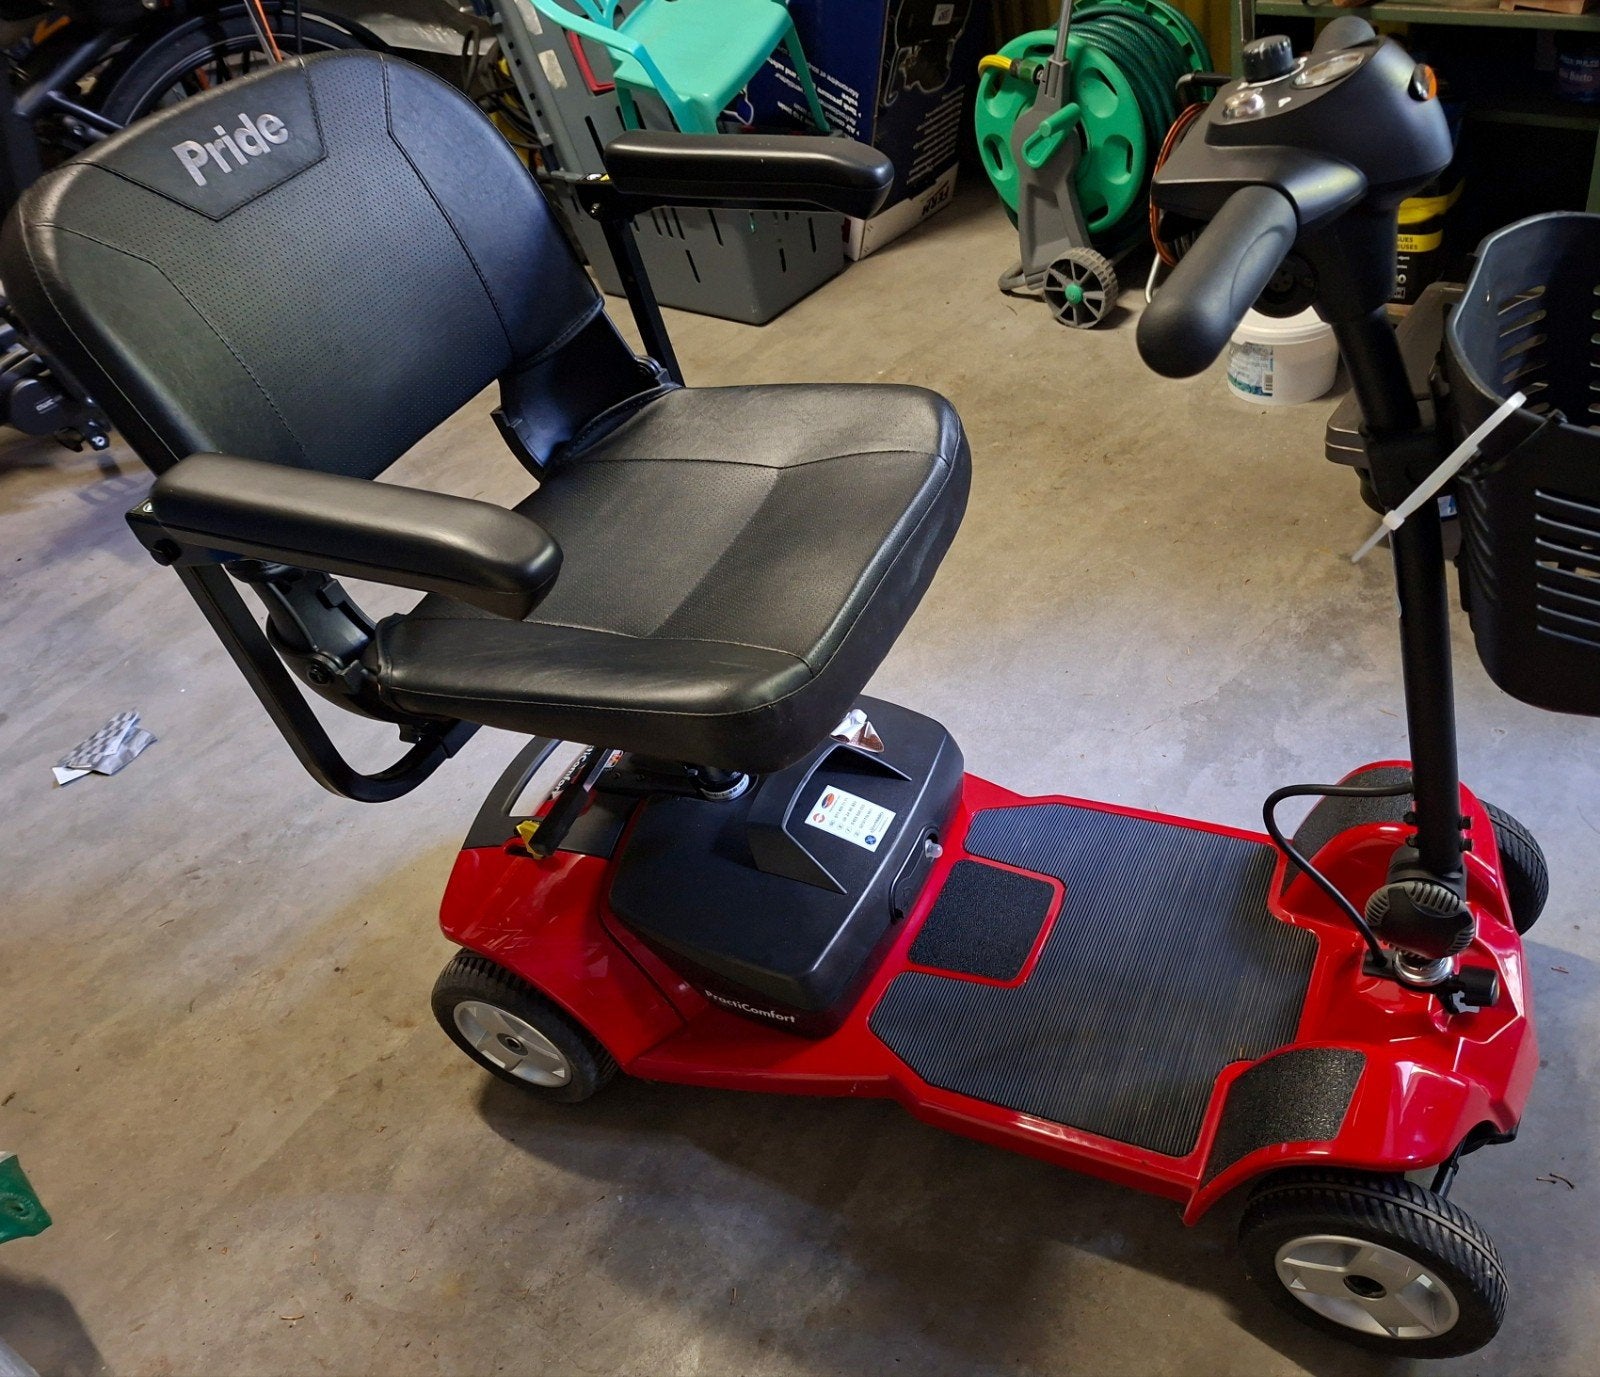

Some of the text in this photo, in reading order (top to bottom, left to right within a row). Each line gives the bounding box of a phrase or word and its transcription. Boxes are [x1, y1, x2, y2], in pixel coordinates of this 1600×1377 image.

[785, 67, 797, 78] and
[817, 87, 843, 106] pressure
[843, 103, 857, 116] Tank
[171, 113, 288, 187] Pride
[704, 989, 795, 1023] PractiComfort
